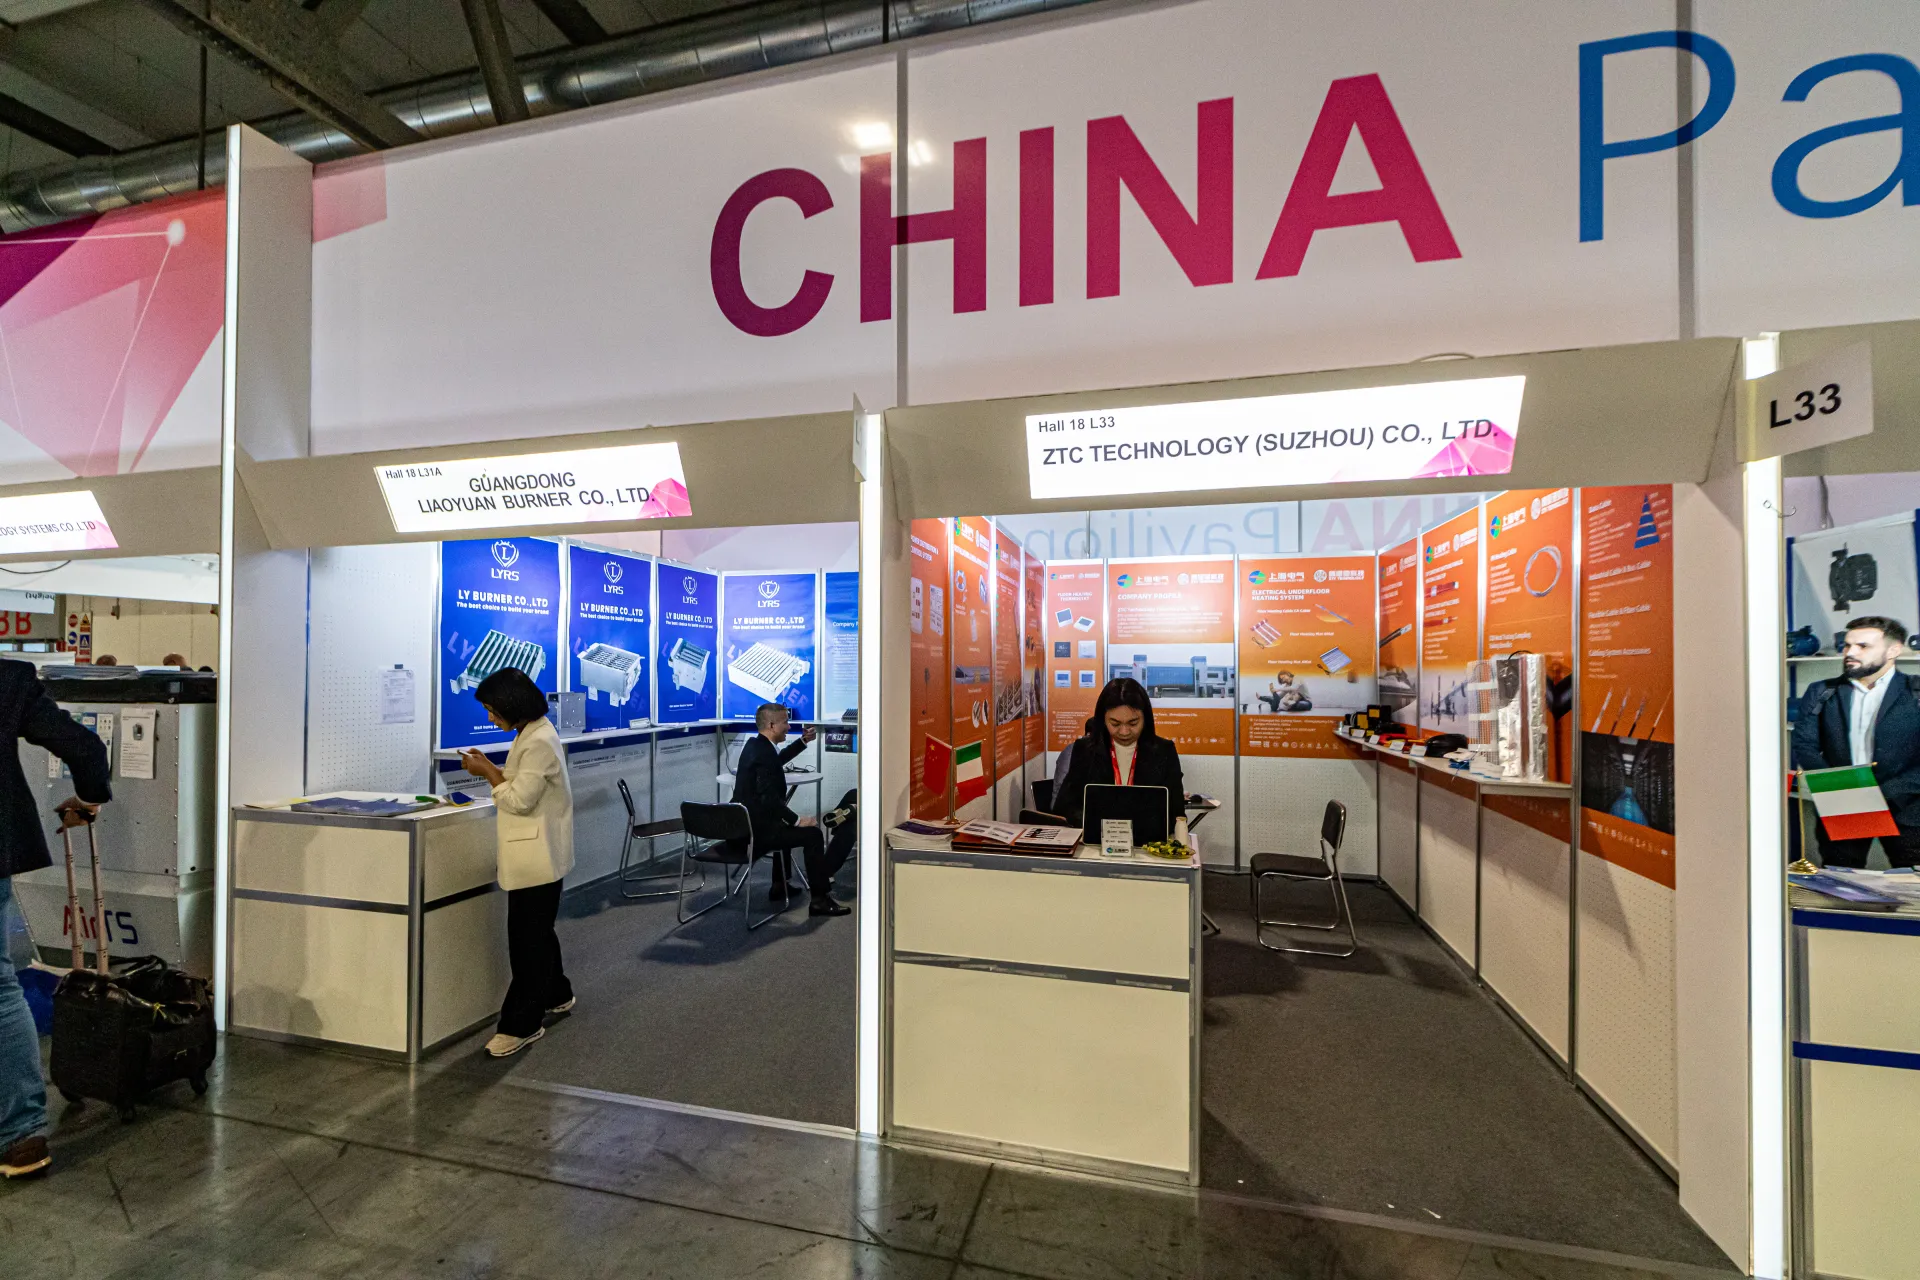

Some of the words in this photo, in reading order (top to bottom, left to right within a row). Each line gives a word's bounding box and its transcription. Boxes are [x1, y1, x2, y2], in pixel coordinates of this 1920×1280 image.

[710, 72, 1462, 337] CHINA
[1770, 383, 1842, 428] L33
[1038, 419, 1065, 433] Hall
[1069, 418, 1086, 431] 18
[1090, 416, 1116, 429] L33
[1043, 447, 1085, 465] ZTC
[1090, 435, 1250, 463] TECHNOLOGY
[1256, 427, 1375, 457] (SUZHOU)
[1382, 424, 1432, 446] CO.,
[1441, 418, 1499, 441] LTD.
[385, 469, 404, 479] Hall
[405, 468, 417, 479] 18
[418, 467, 442, 478] L31A
[469, 472, 576, 493] GUANGDONG
[418, 496, 497, 513] LIAOYUAN
[502, 491, 572, 509] BURNER
[579, 489, 614, 506] CO.,
[616, 487, 656, 503] LTD.
[18, 523, 60, 535] SYSTEMS
[490, 568, 520, 581] LYRS
[603, 584, 624, 595] LYRS
[458, 590, 471, 600] LY
[472, 590, 513, 604] BURNER
[682, 595, 698, 605] LYRS
[482, 603, 500, 611] choice
[580, 602, 590, 611] LY
[590, 603, 619, 614] BURNER
[757, 600, 780, 608] LYRS
[665, 612, 672, 620] LY
[673, 612, 694, 622] BURNER
